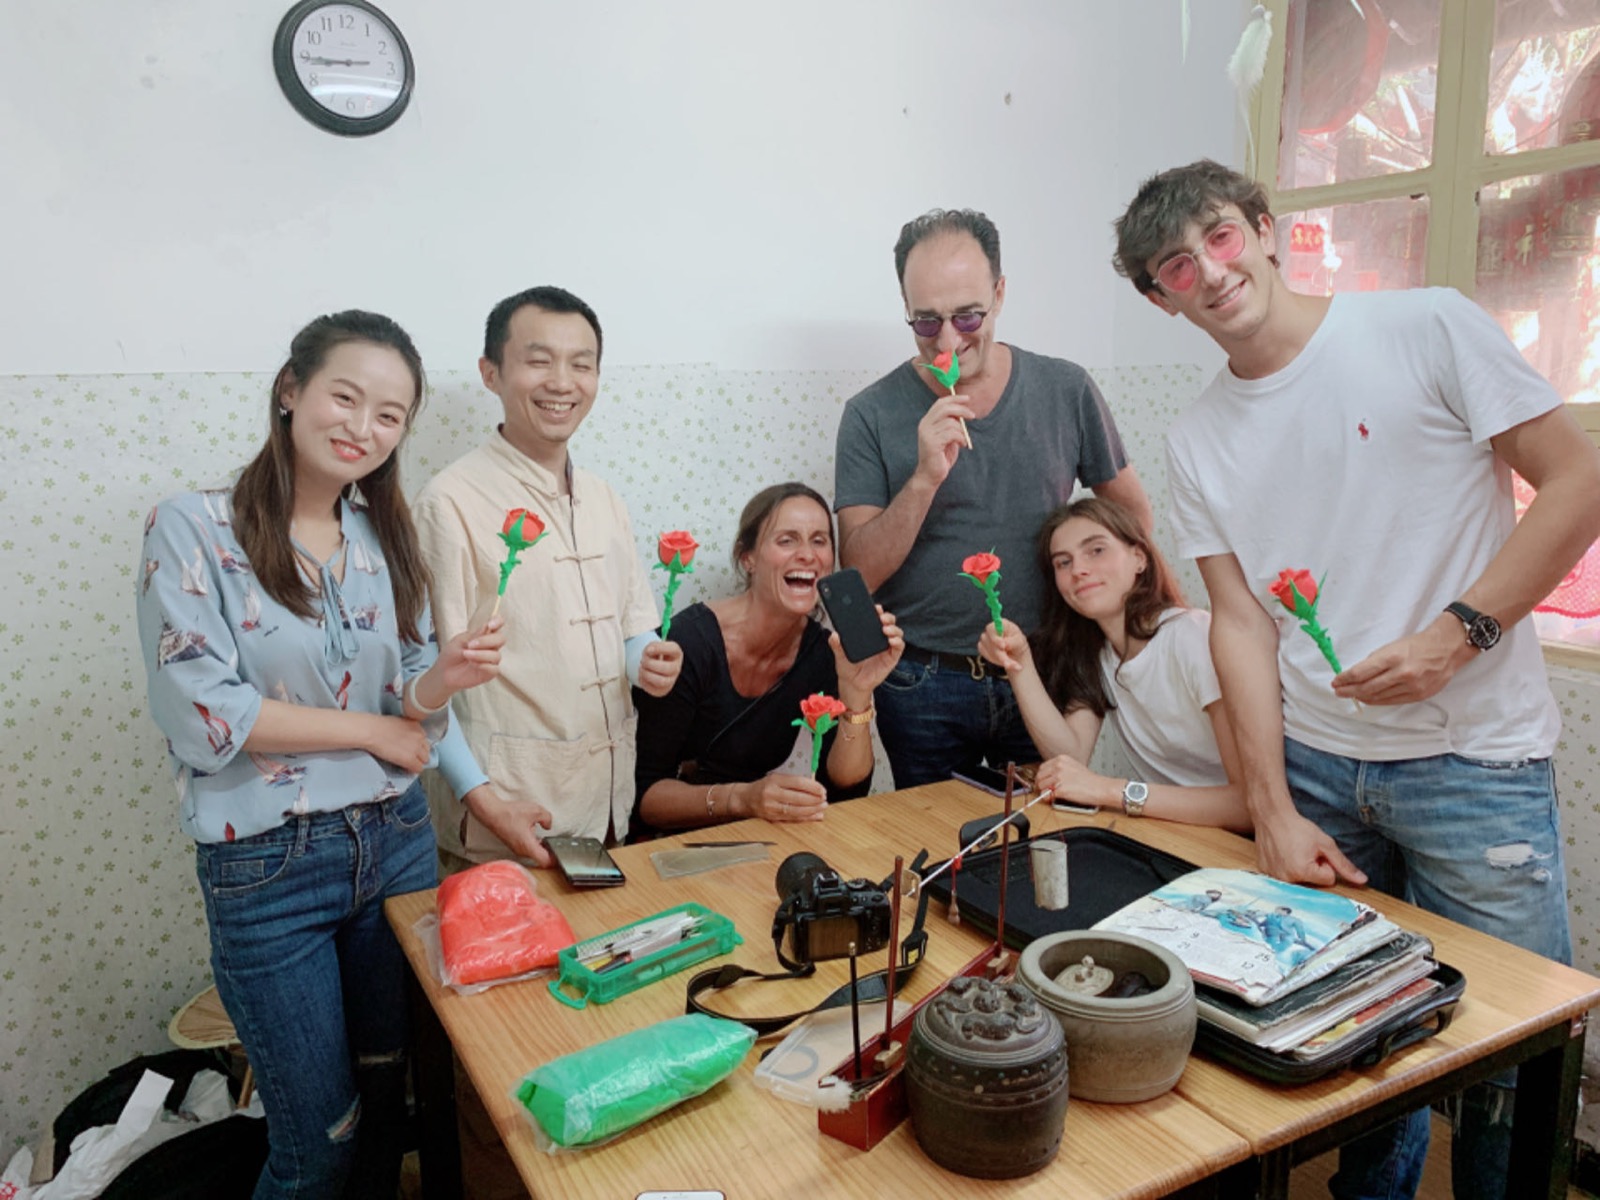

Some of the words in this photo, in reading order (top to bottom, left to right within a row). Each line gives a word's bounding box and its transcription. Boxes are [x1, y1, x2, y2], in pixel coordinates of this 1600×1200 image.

[321, 16, 332, 32] 11
[339, 14, 355, 29] 12
[364, 22, 370, 37] 1
[307, 30, 321, 45] 10
[378, 40, 387, 56] 2
[299, 49, 311, 63] 9
[386, 61, 396, 76] 3
[309, 72, 319, 87] 8
[345, 97, 356, 111] 6
